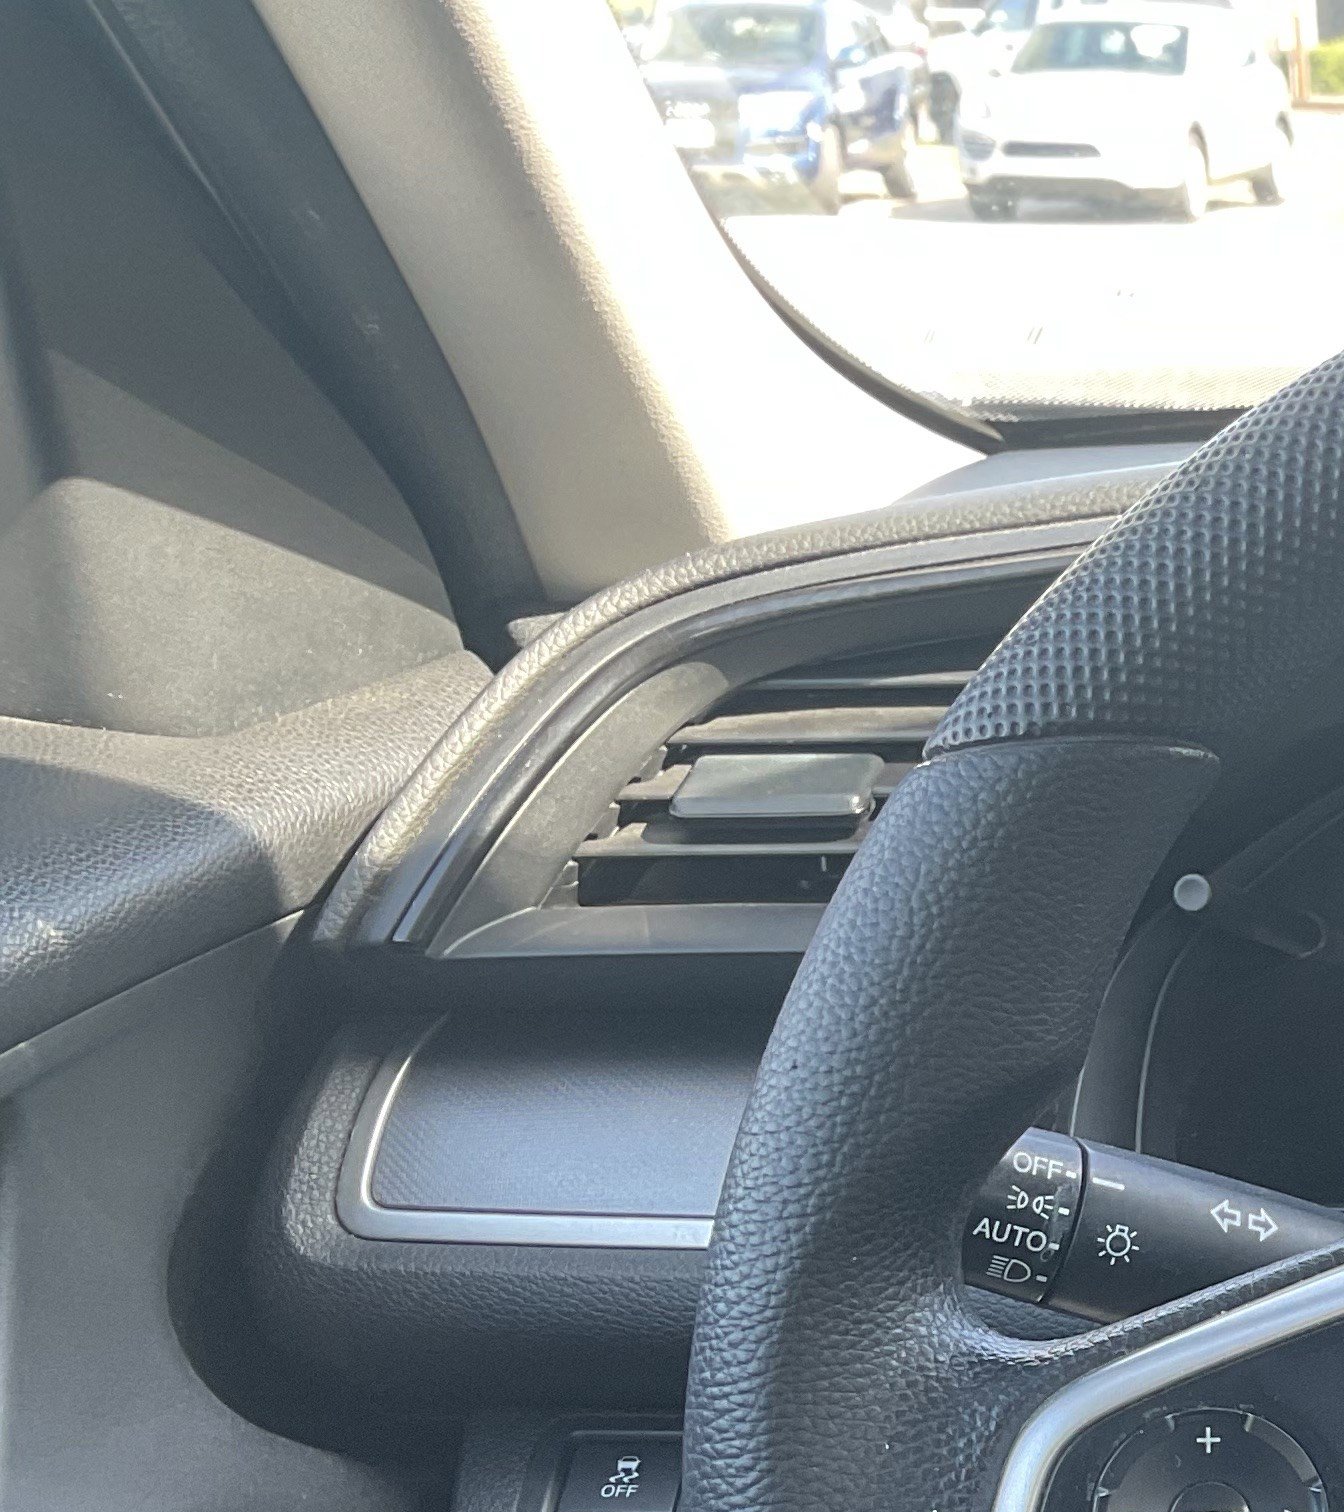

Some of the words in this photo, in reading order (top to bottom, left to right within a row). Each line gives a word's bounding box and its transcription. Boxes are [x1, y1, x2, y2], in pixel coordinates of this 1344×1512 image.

[1011, 1151, 1064, 1180] OFF
[972, 1216, 1048, 1253] AUTO
[600, 1483, 640, 1499] OFF
